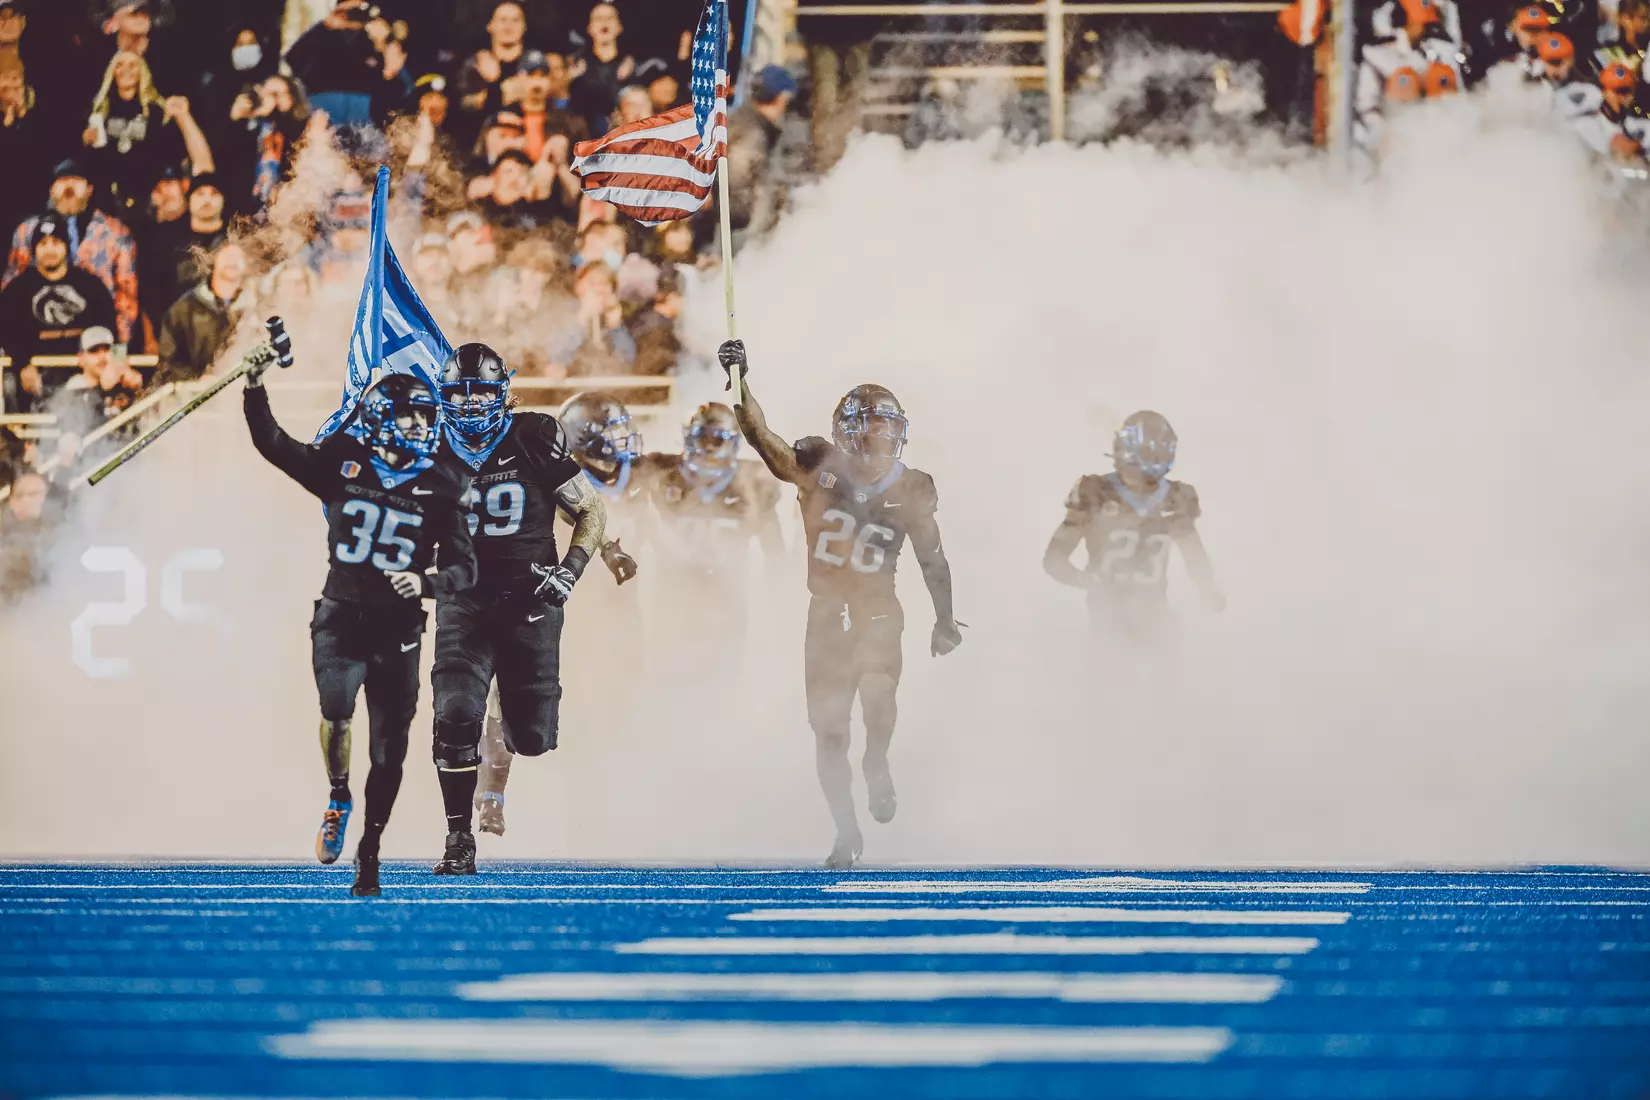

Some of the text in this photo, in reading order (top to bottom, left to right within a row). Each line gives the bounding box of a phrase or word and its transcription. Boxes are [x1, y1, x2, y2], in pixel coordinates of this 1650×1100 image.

[481, 469, 518, 484] STATE
[336, 499, 424, 571] 35
[814, 509, 895, 573] 26
[1101, 529, 1172, 584] 23
